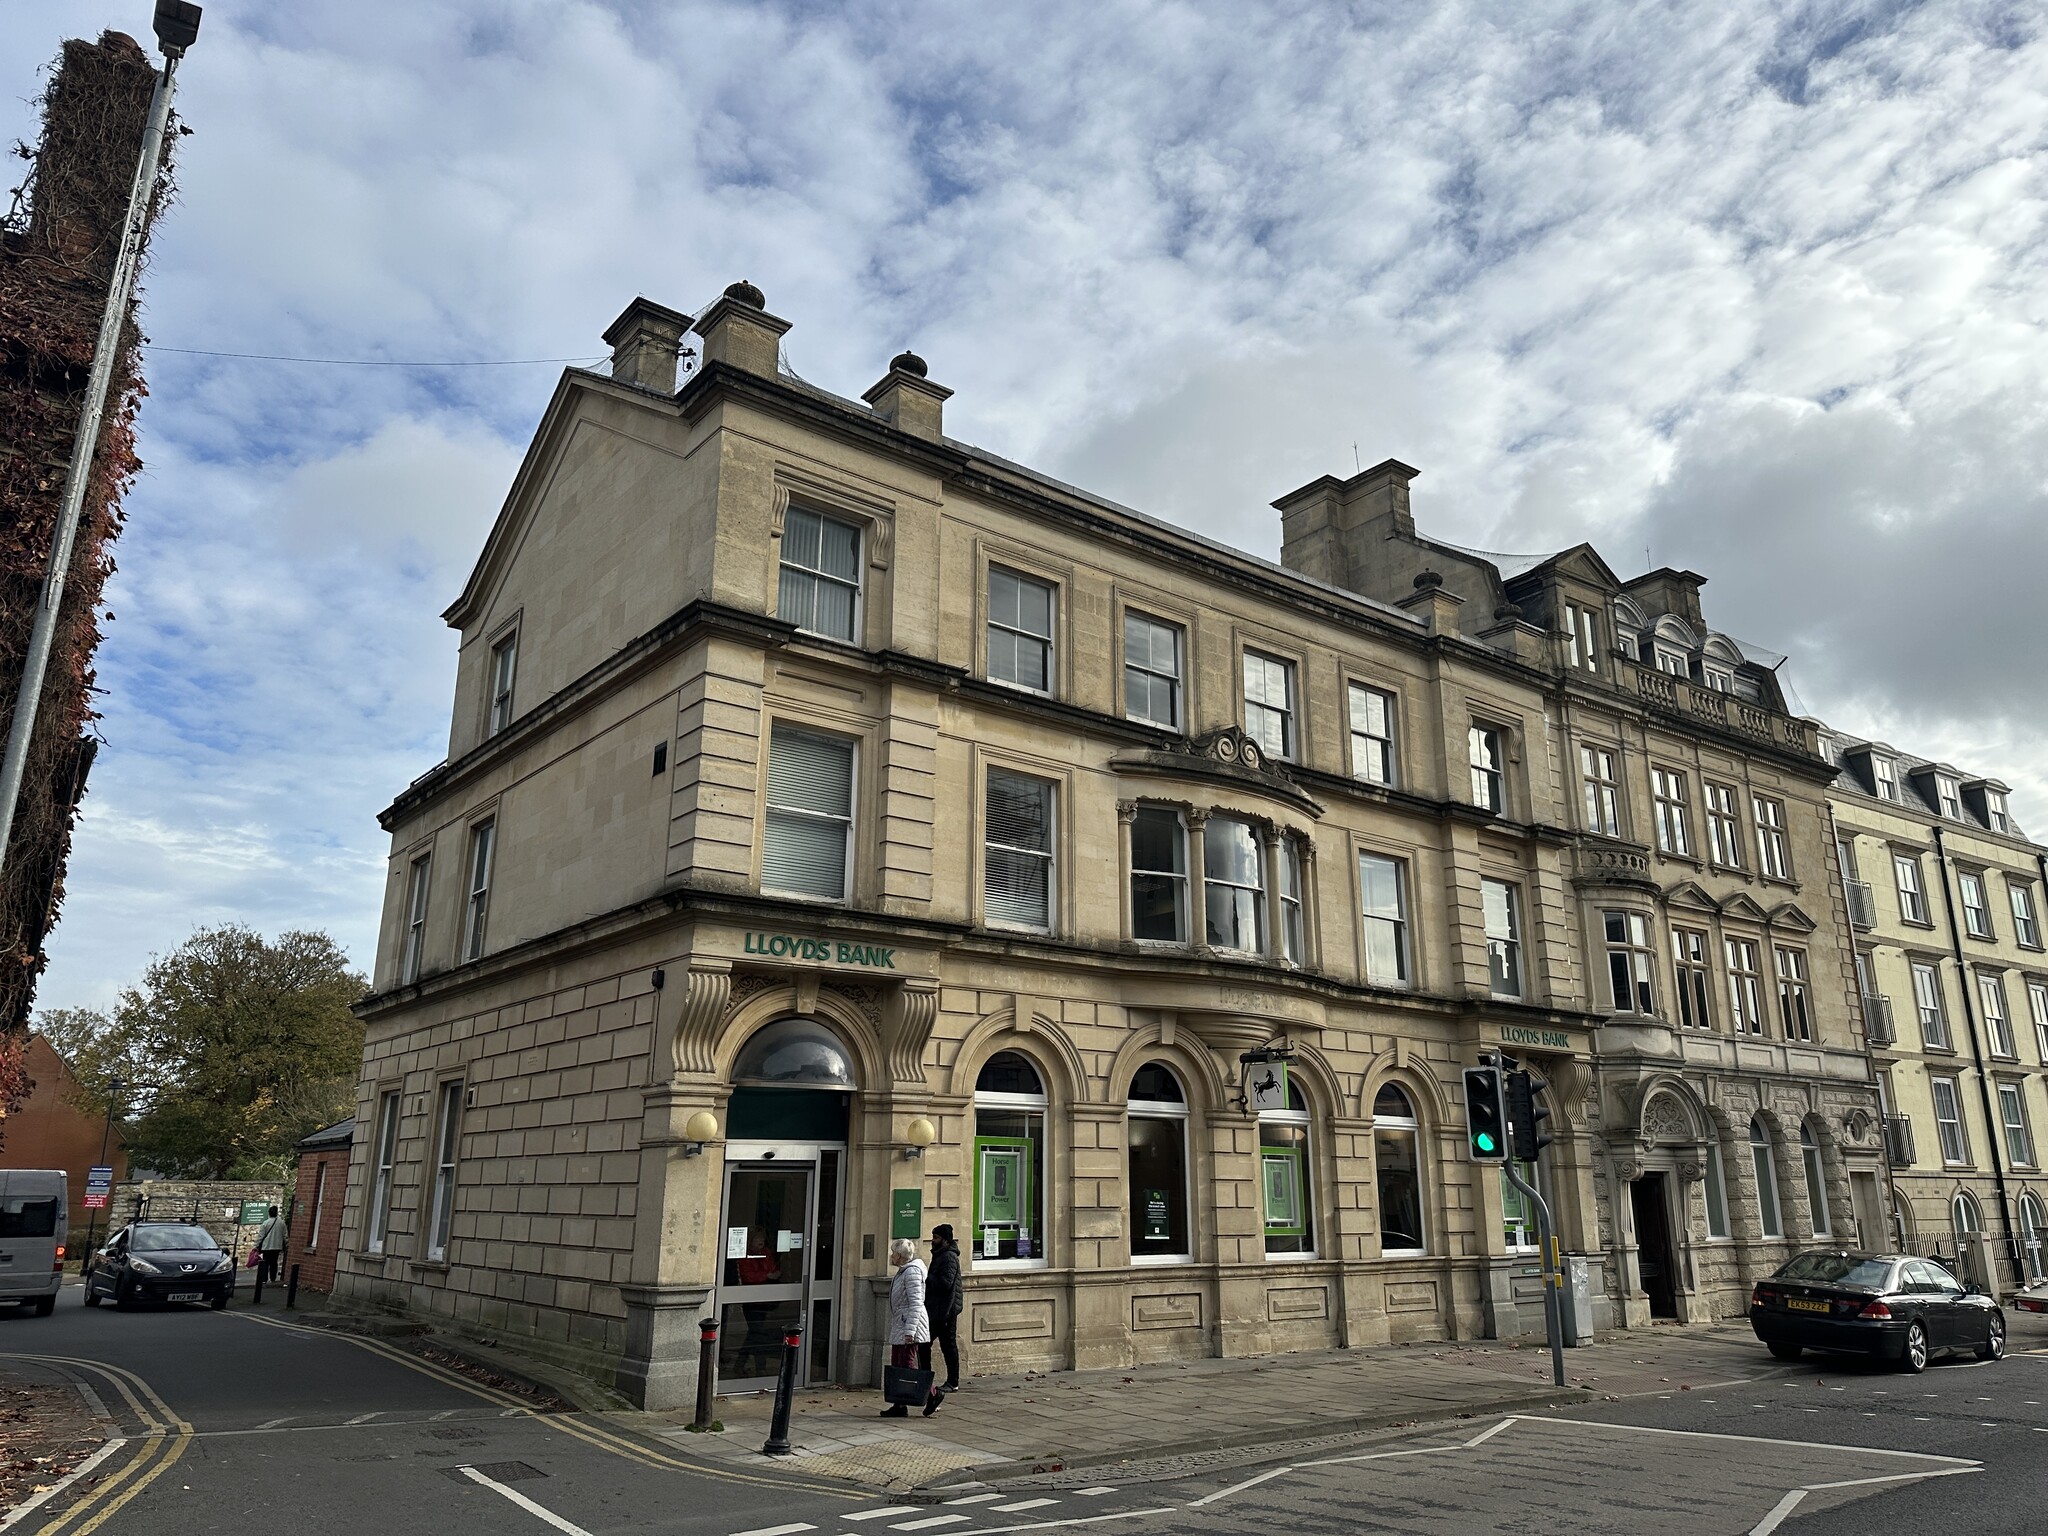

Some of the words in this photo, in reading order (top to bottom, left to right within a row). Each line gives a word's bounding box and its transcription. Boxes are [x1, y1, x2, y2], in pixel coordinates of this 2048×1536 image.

[745, 933, 831, 961] LLOYDS
[837, 942, 896, 969] BANK
[1501, 1026, 1540, 1045] LLOYDS
[1542, 1031, 1570, 1049] BANK
[1790, 1300, 1810, 1309] EK53
[1811, 1302, 1827, 1311] ZZF
